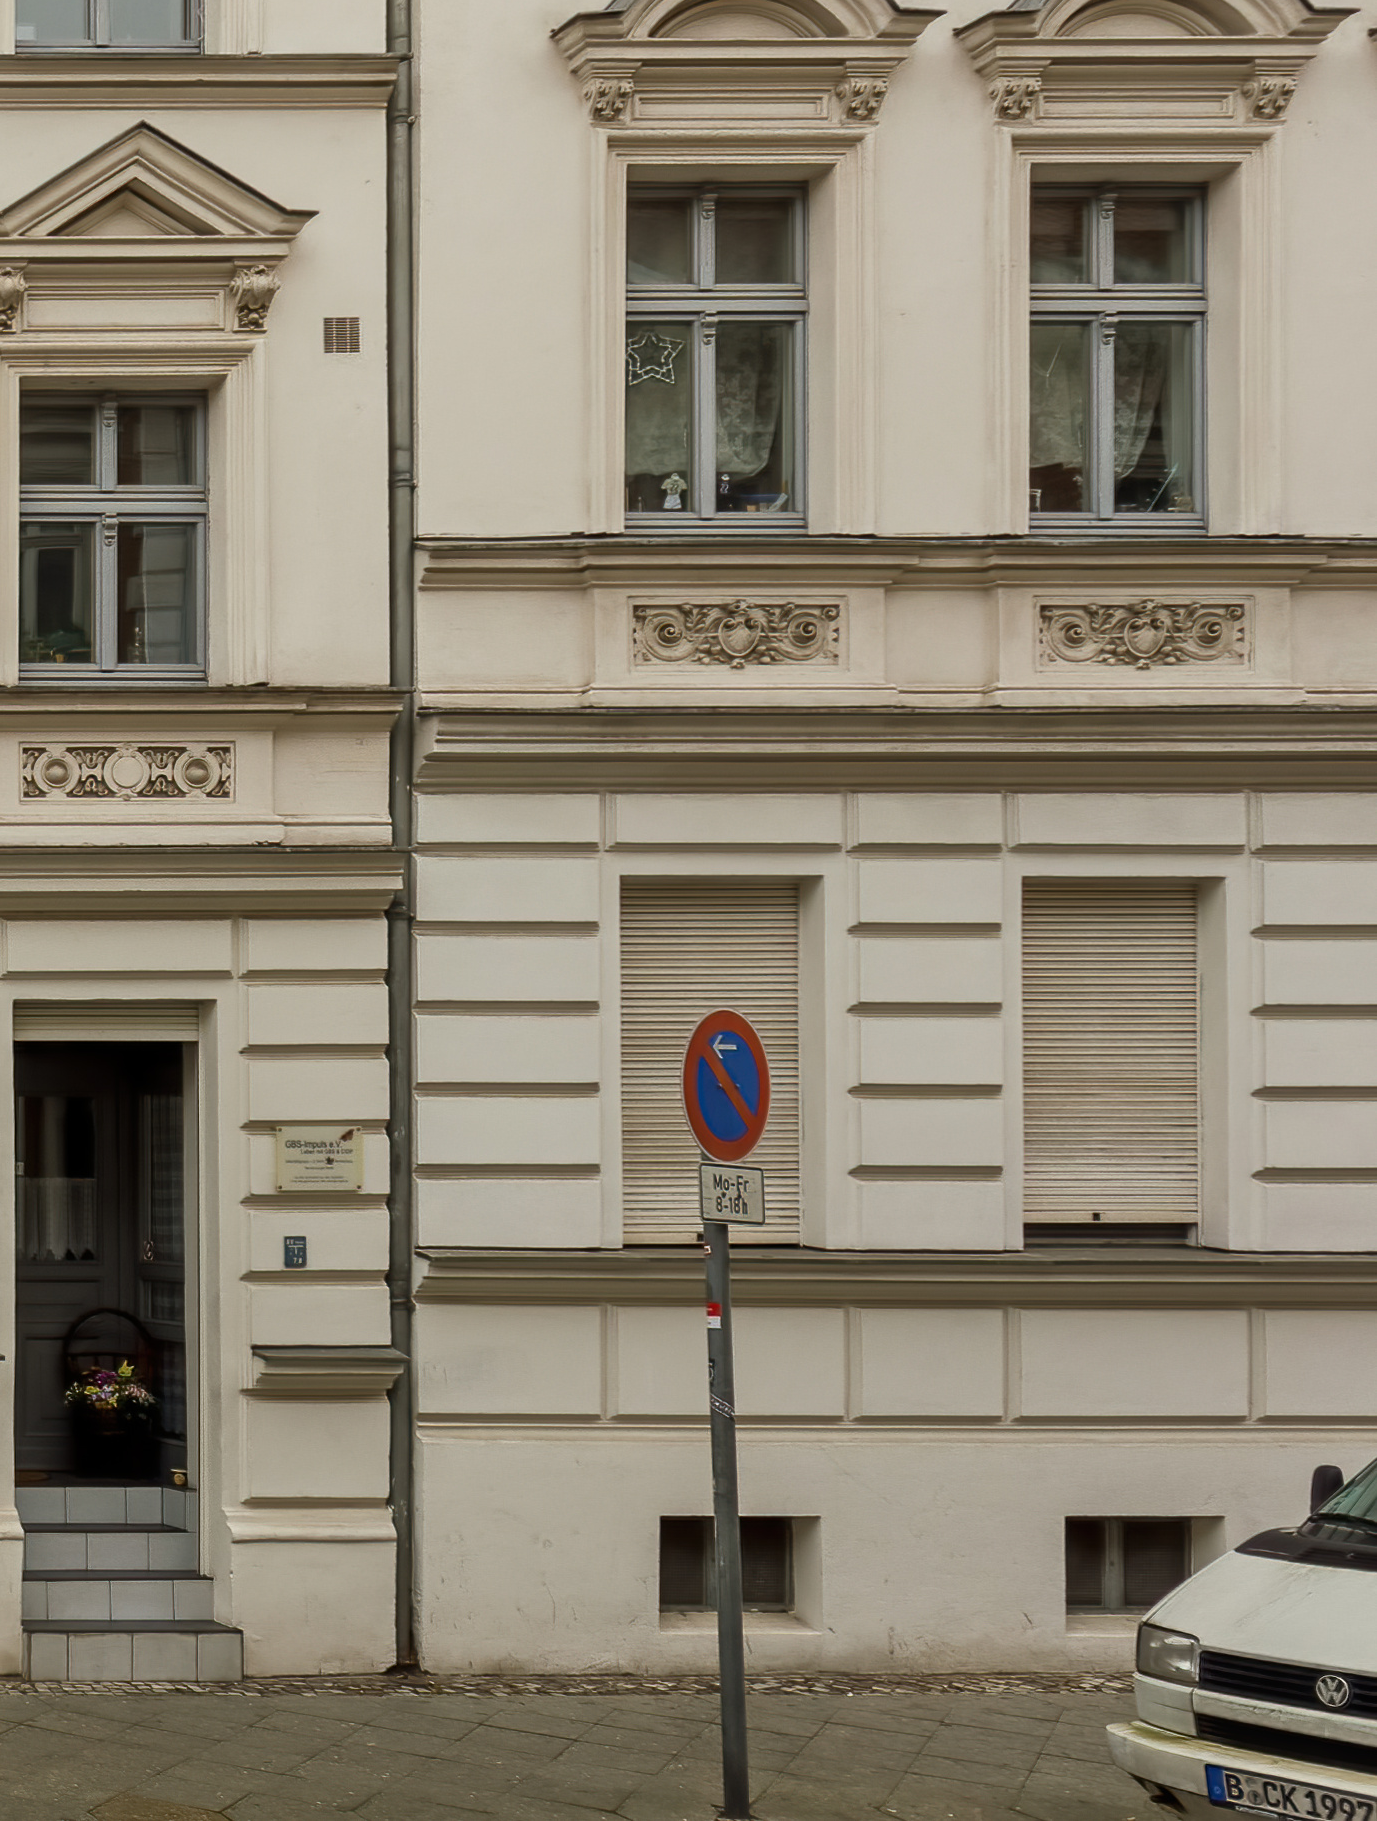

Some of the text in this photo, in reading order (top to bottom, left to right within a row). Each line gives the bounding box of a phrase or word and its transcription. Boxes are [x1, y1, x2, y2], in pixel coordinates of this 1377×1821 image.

[285, 1140, 327, 1149] GBS-Impuls
[713, 1173, 749, 1192] Mo-Fr
[1225, 1773, 1374, 1821] B CK 1997
